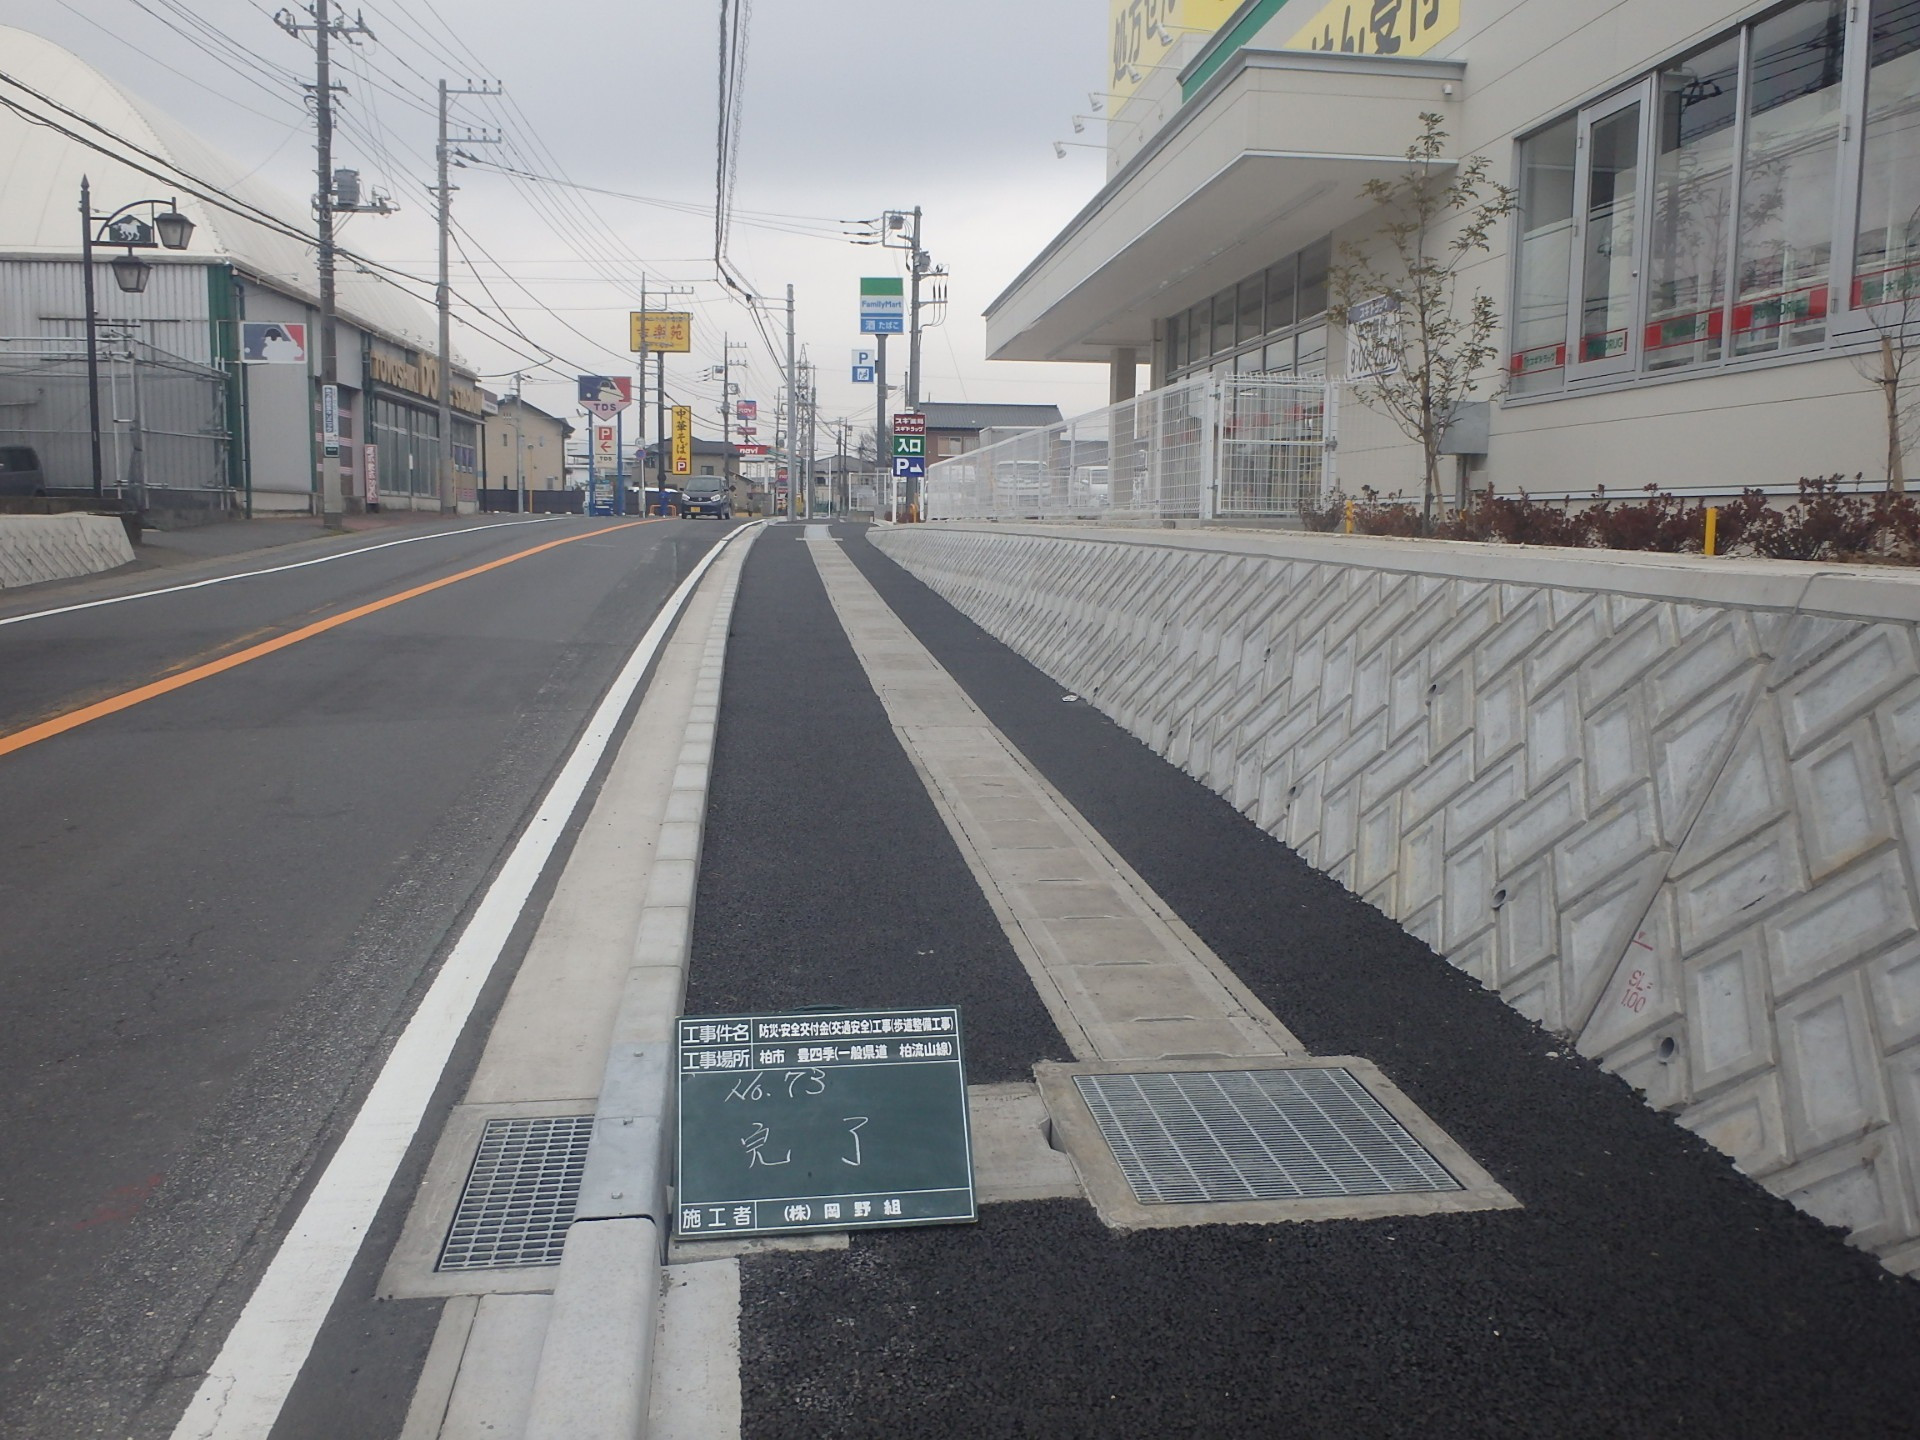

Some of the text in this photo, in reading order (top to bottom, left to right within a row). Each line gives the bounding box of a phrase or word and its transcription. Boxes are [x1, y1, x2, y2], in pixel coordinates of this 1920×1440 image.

[861, 300, 902, 309] FamilyMart
[636, 323, 684, 341] 楽苑
[878, 321, 900, 330] たばこ
[858, 352, 869, 365] P
[594, 403, 617, 412] TDS
[601, 431, 610, 440] P
[676, 409, 688, 454] 中華そば
[739, 447, 759, 455] navi
[897, 438, 921, 453] 入口
[677, 462, 687, 472] P
[896, 458, 910, 475] P
[682, 1023, 750, 1044] 工事件名
[682, 1049, 751, 1070] 工事場所
[759, 1049, 786, 1065] 柏市
[899, 1041, 953, 1058] 柏流山線)
[725, 1066, 826, 1103] No. 73
[682, 1206, 752, 1230] 施工者
[783, 1198, 903, 1223] (株) 岡野組
